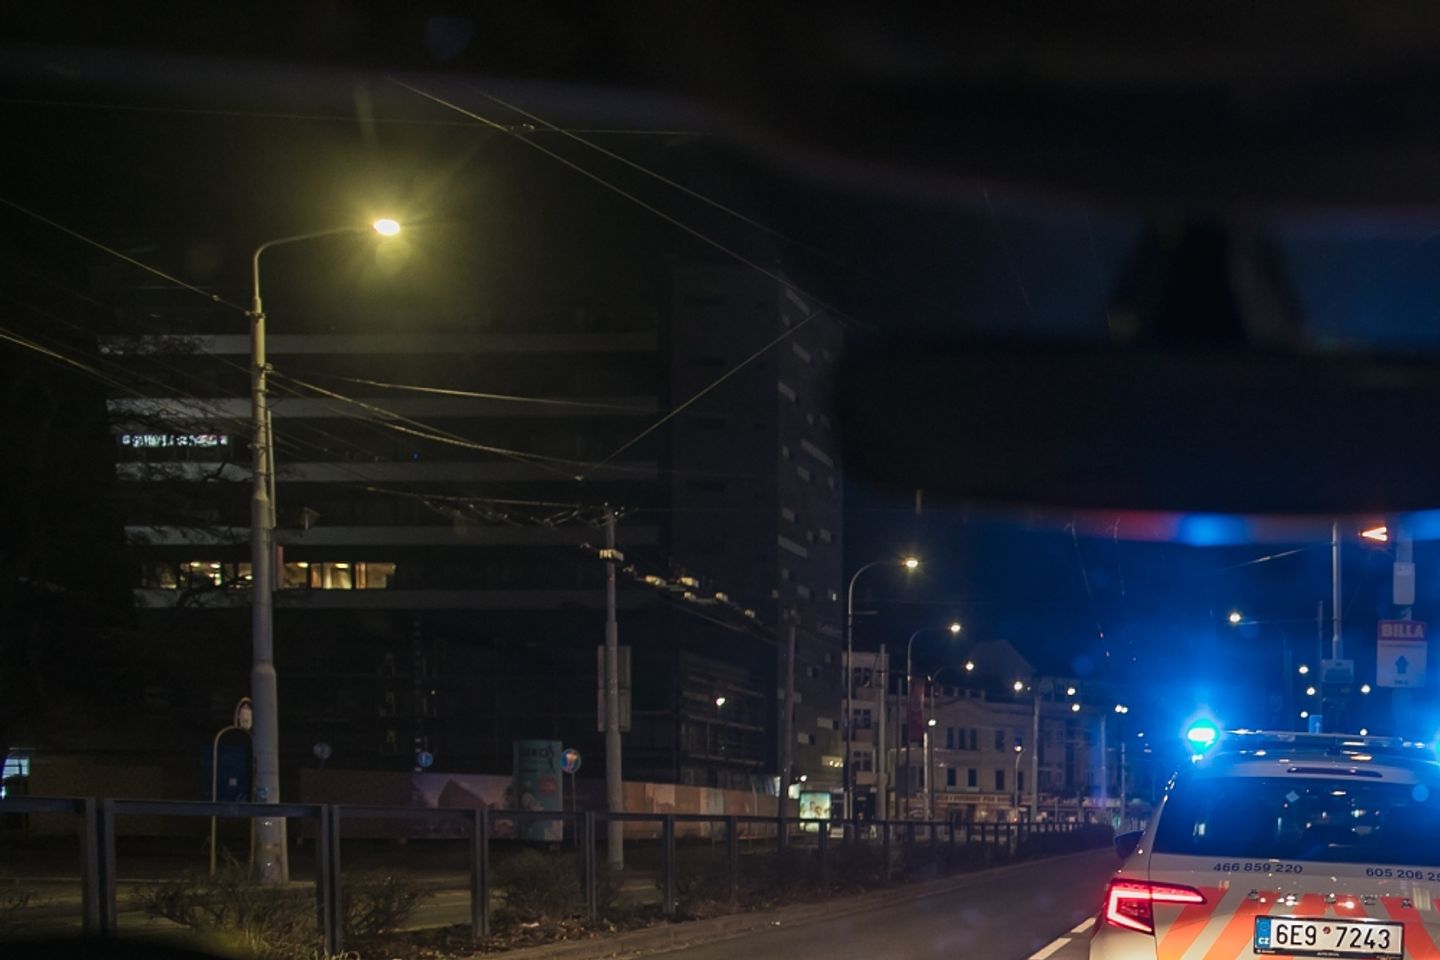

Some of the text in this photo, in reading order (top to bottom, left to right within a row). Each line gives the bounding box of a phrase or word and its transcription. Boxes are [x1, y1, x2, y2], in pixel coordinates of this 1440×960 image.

[1381, 623, 1425, 638] BILLA
[1213, 862, 1303, 874] 466 859 220
[1365, 867, 1393, 878] 605
[1399, 869, 1424, 881] 206
[1258, 924, 1391, 950] CZ 6E9 7243
